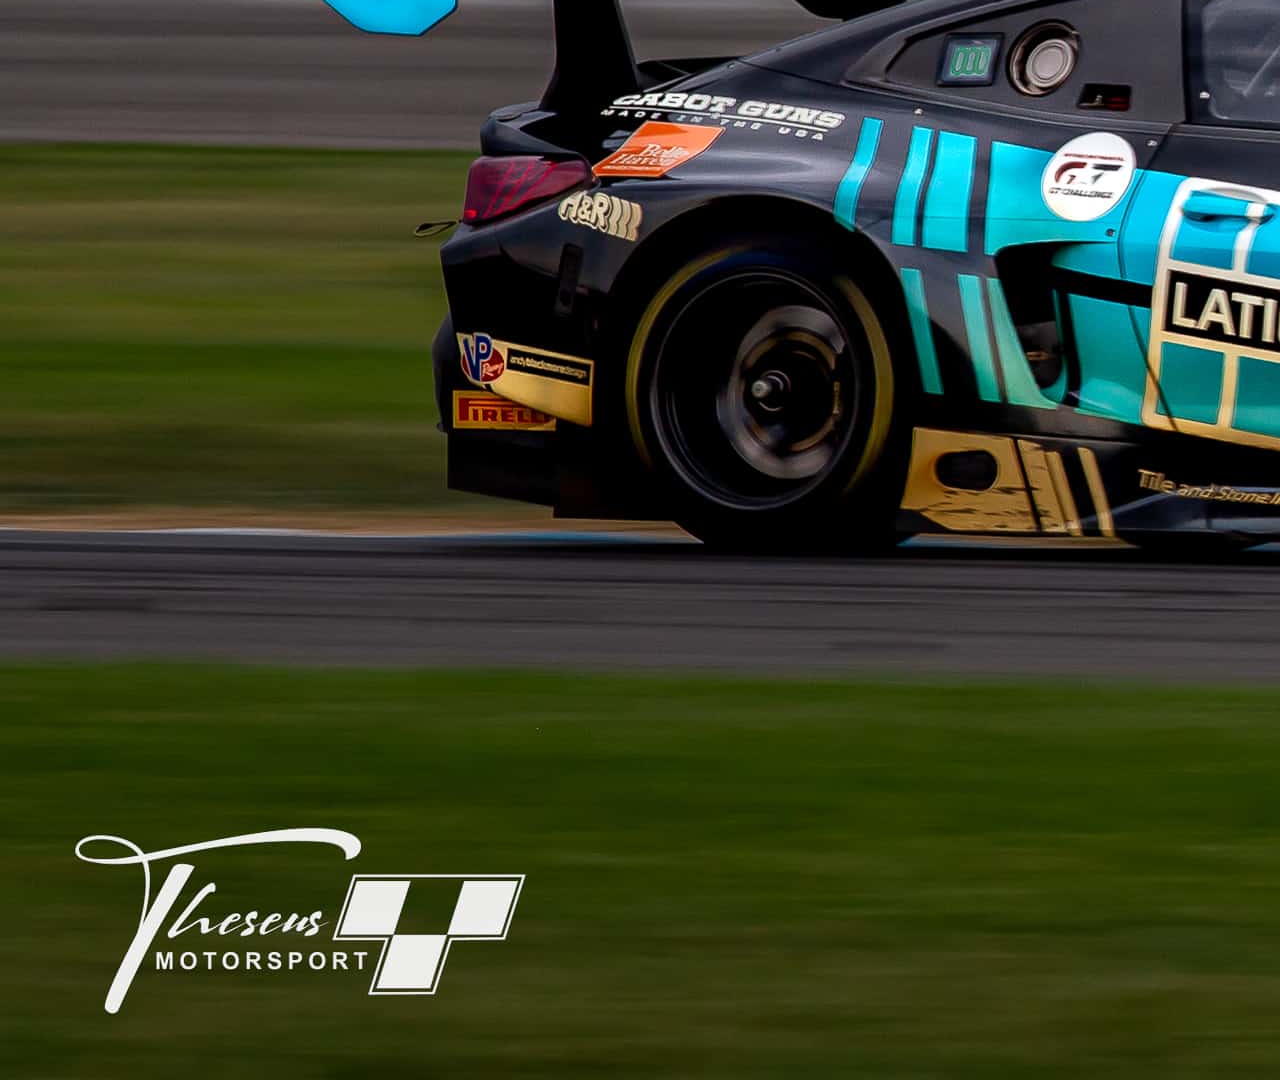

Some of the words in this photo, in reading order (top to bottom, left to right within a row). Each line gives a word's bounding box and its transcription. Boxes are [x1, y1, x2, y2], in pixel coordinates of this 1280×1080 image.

[600, 109, 660, 121] MADE
[778, 127, 825, 142] USA
[613, 93, 737, 114] CABOT
[737, 101, 846, 129] GUNS
[557, 192, 614, 232] H&R
[462, 334, 493, 382] VP
[1138, 469, 1176, 494] Tile
[1177, 483, 1214, 500] and
[1216, 486, 1270, 505] Stone
